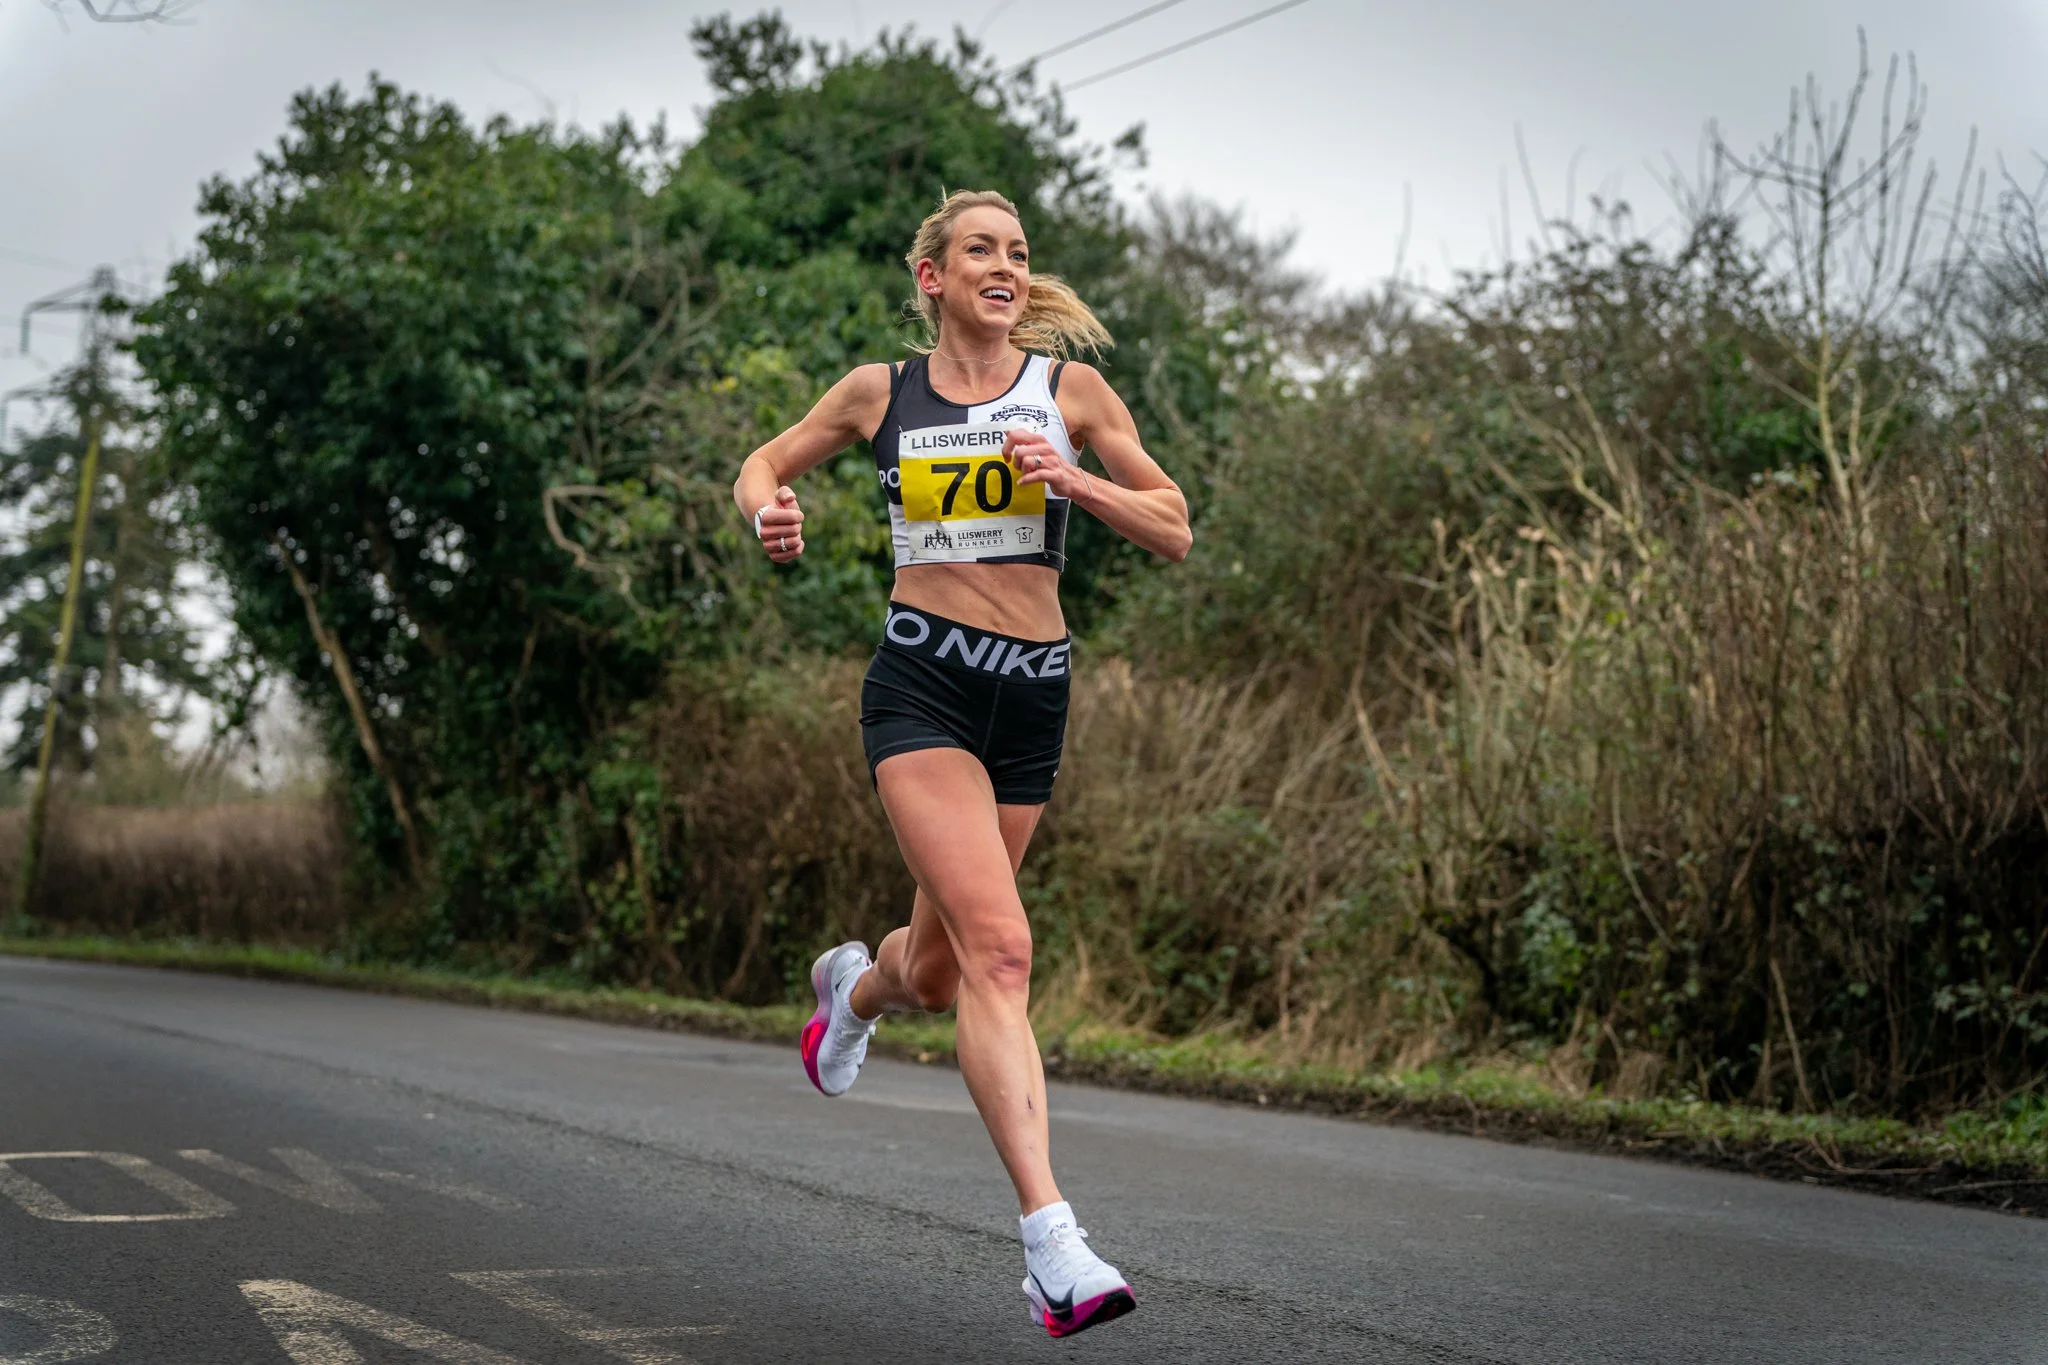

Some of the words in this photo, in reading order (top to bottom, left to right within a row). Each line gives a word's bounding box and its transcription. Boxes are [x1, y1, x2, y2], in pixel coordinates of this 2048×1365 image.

[911, 430, 1008, 450] LLISWERR
[931, 460, 1013, 517] 70
[957, 529, 1003, 539] LLISWERRY
[1022, 532, 1027, 540] S
[958, 539, 1004, 547] RUNNERS
[885, 606, 930, 646] O
[935, 627, 1070, 678] NIKE
